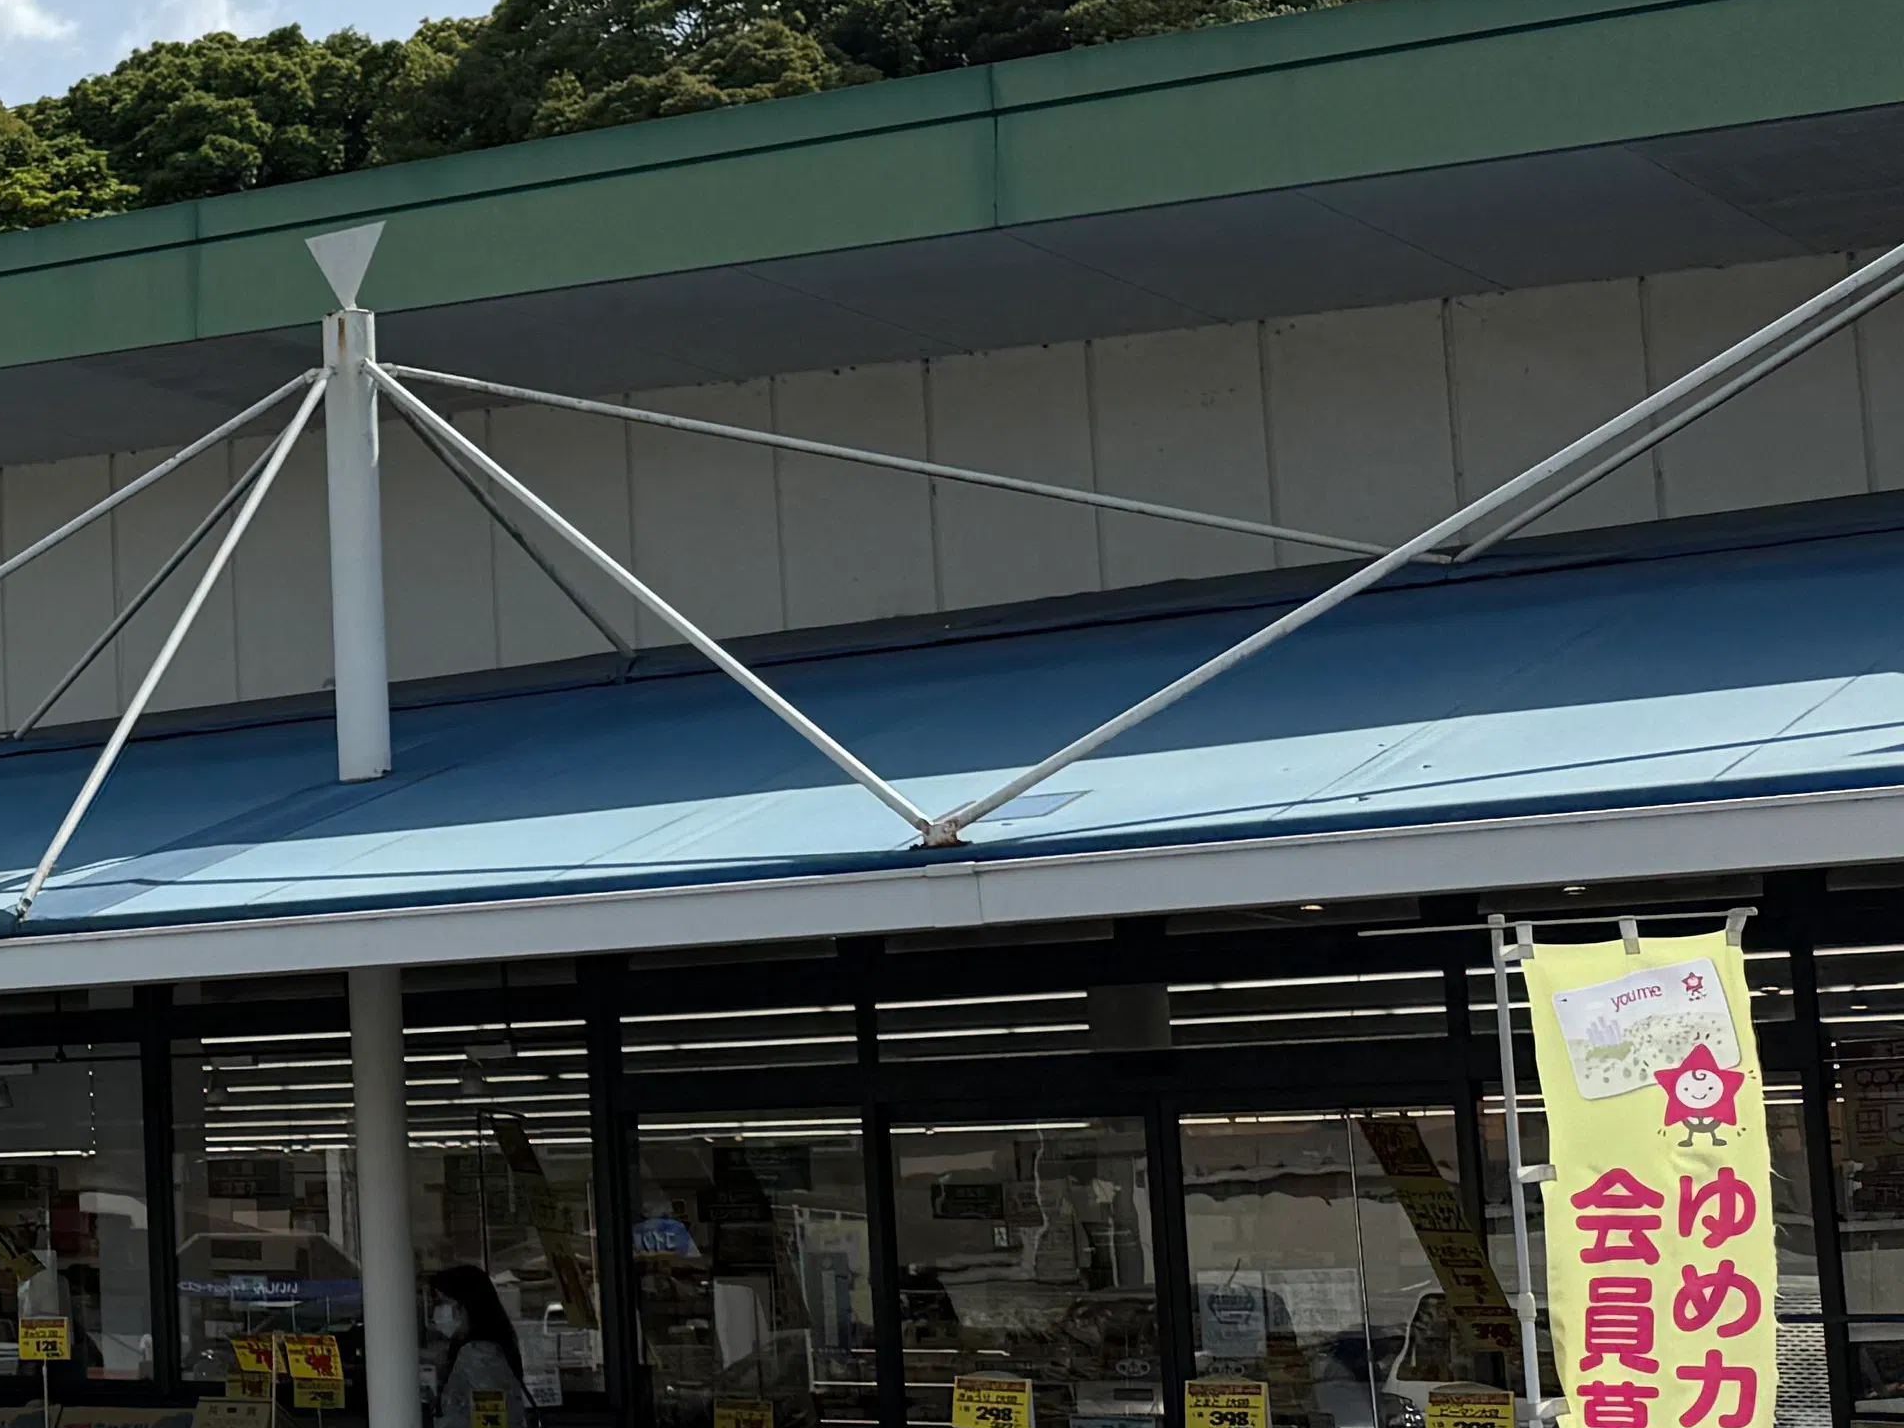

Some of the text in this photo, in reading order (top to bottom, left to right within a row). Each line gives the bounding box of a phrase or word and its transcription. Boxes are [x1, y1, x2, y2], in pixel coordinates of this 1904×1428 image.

[1611, 985, 1662, 1012] youme
[976, 1406, 1012, 1421] 298
[1209, 1411, 1249, 1425] 398
